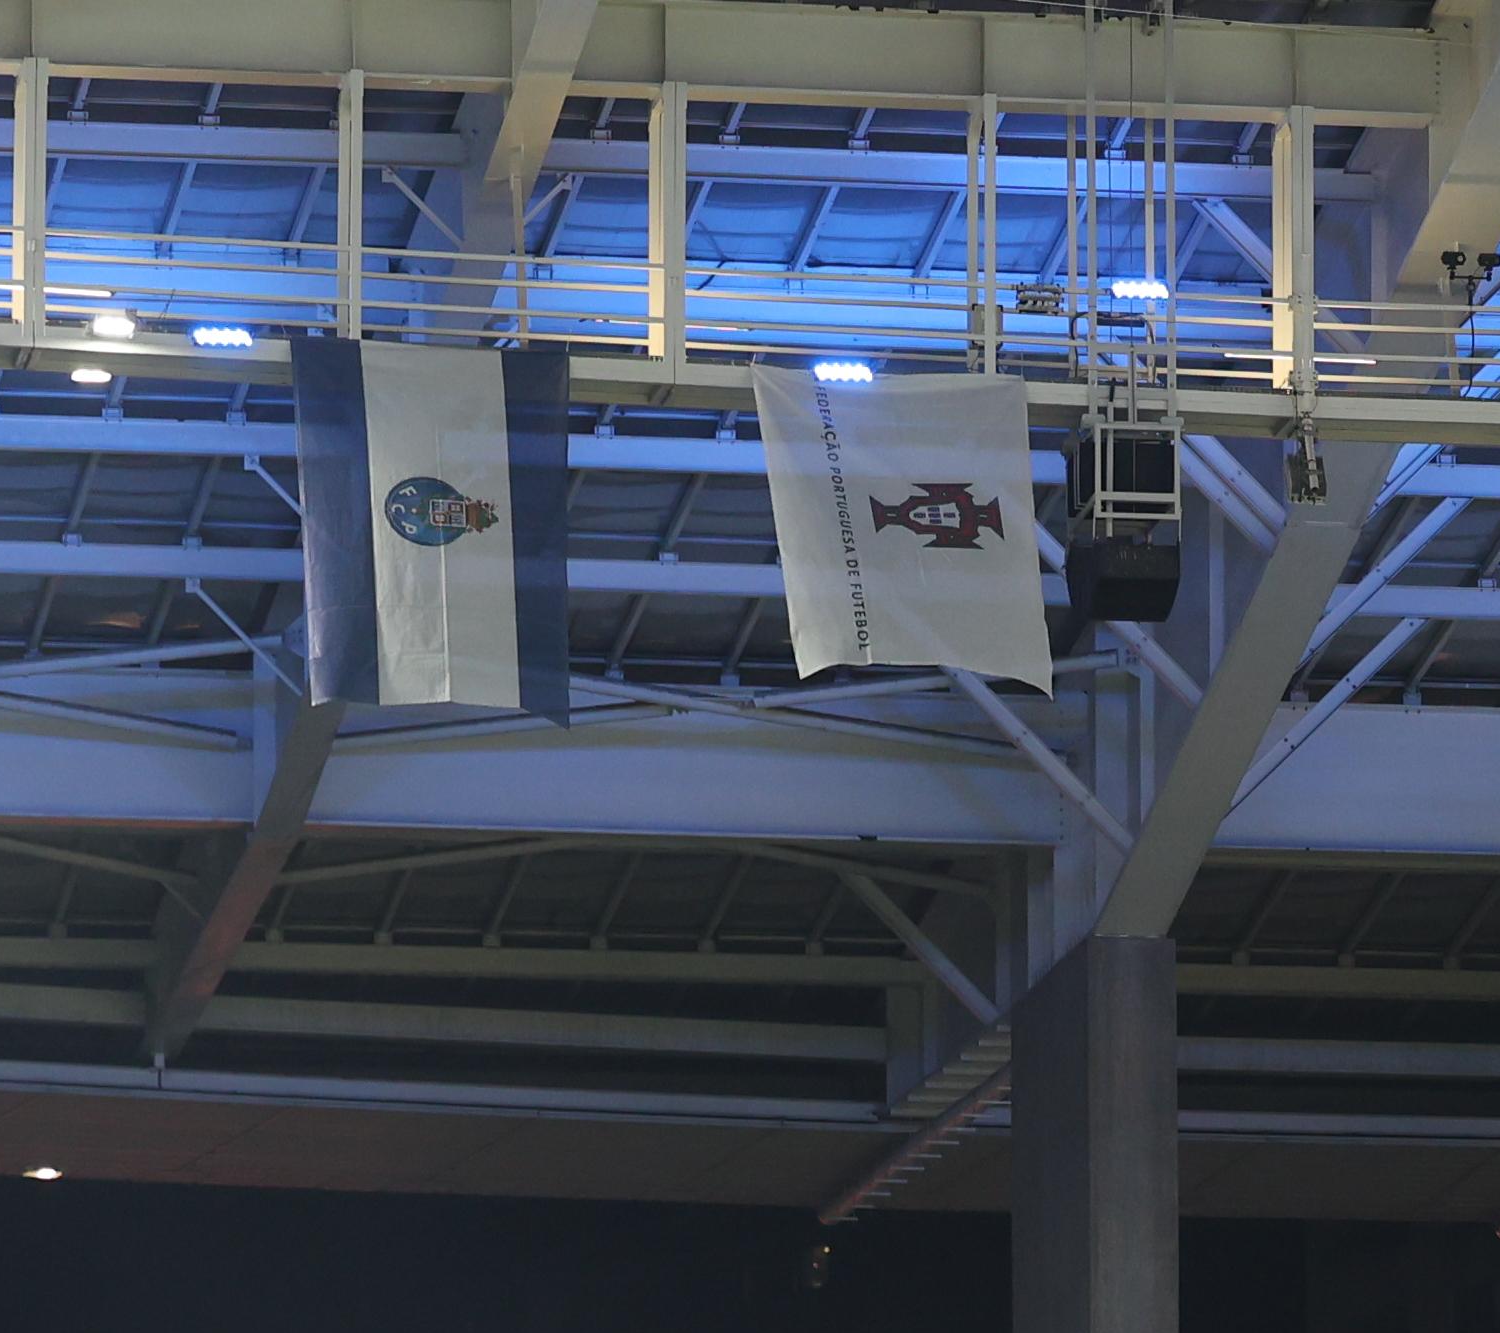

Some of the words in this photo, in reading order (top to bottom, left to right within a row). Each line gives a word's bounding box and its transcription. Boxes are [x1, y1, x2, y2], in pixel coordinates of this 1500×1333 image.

[815, 385, 841, 463] FEDERAÇÃO
[829, 466, 854, 555] PORTUGUESA
[846, 558, 861, 577] DE
[850, 582, 871, 652] FUTEBOL
